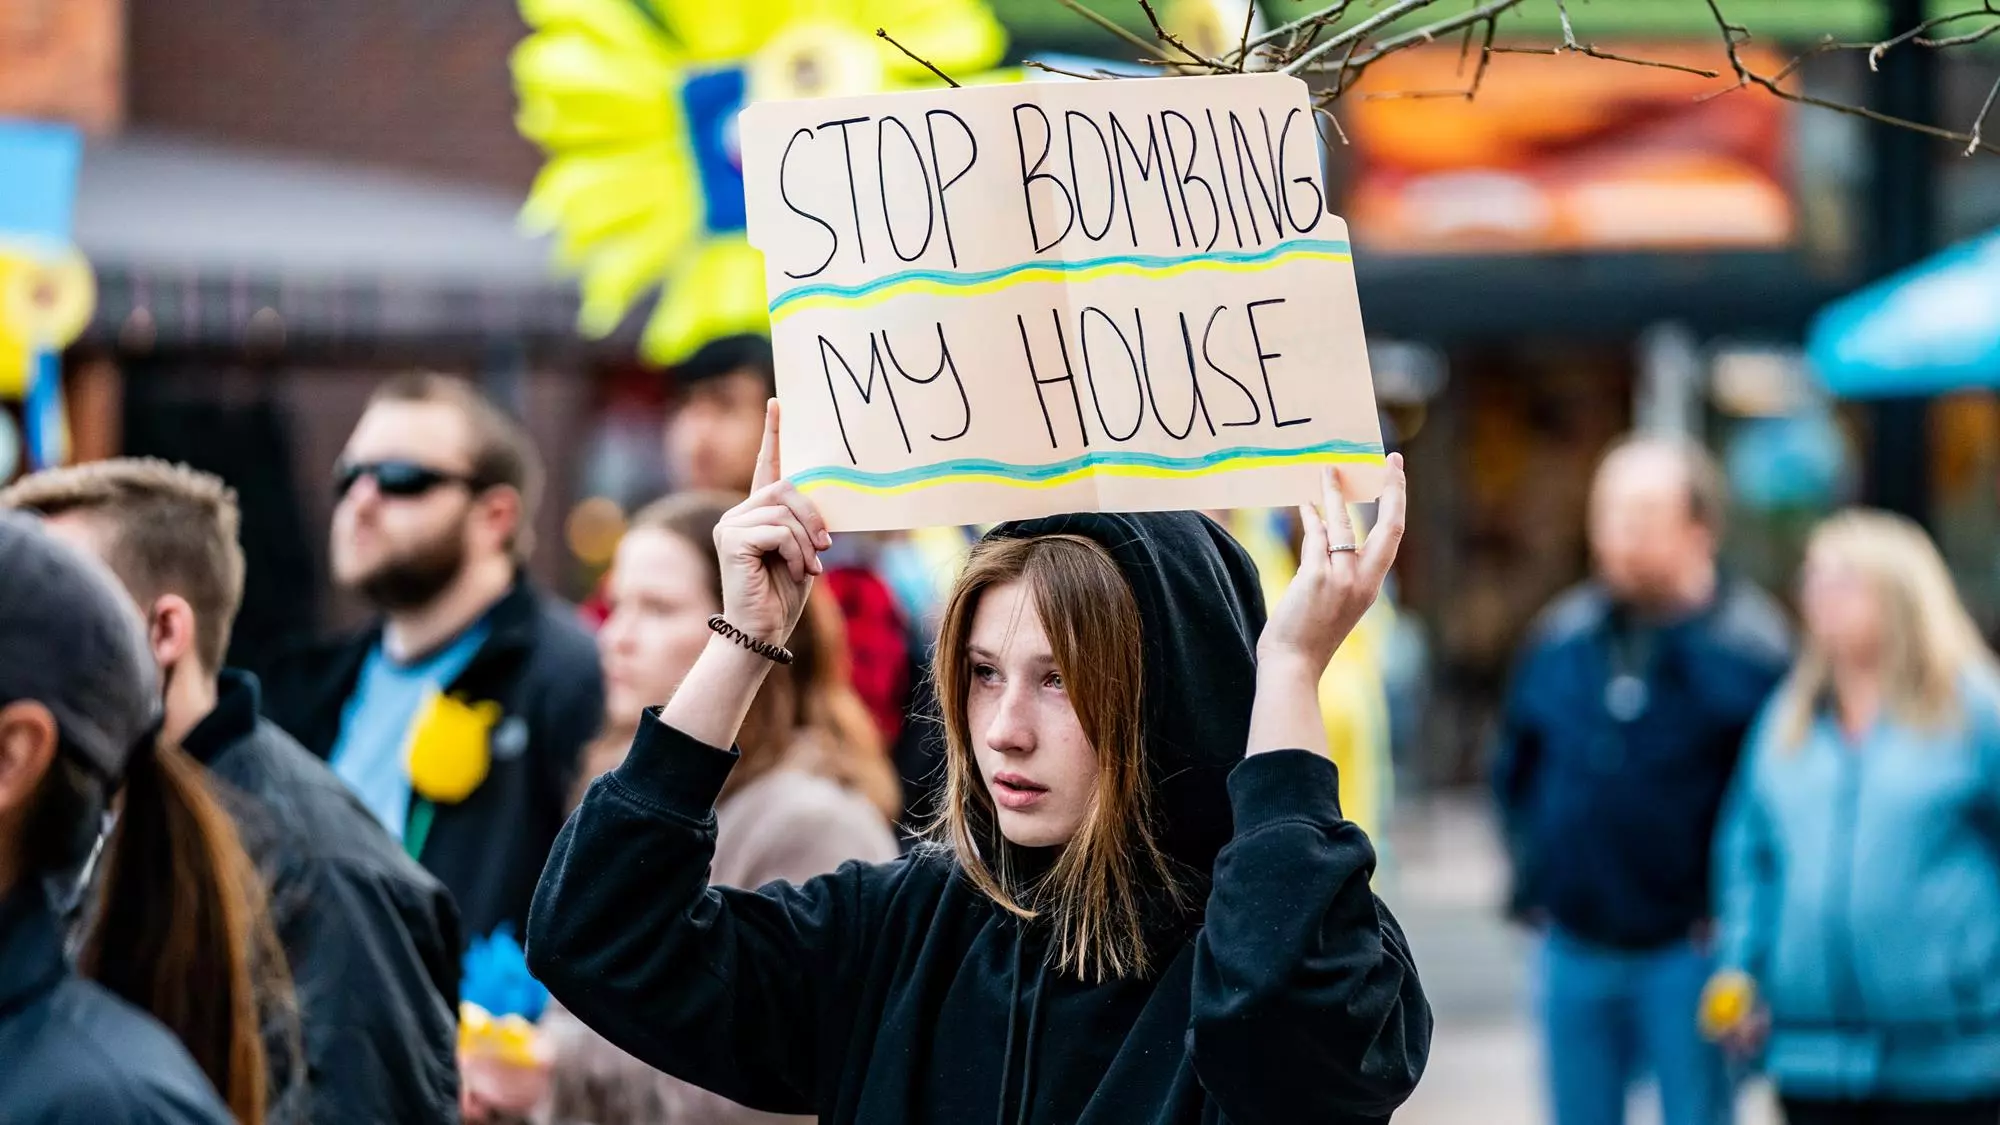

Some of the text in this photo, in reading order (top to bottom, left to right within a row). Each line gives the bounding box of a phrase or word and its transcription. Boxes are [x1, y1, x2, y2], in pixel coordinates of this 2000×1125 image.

[779, 103, 1324, 279] STOP BOMBING
[817, 298, 1312, 466] MY HOUSE
